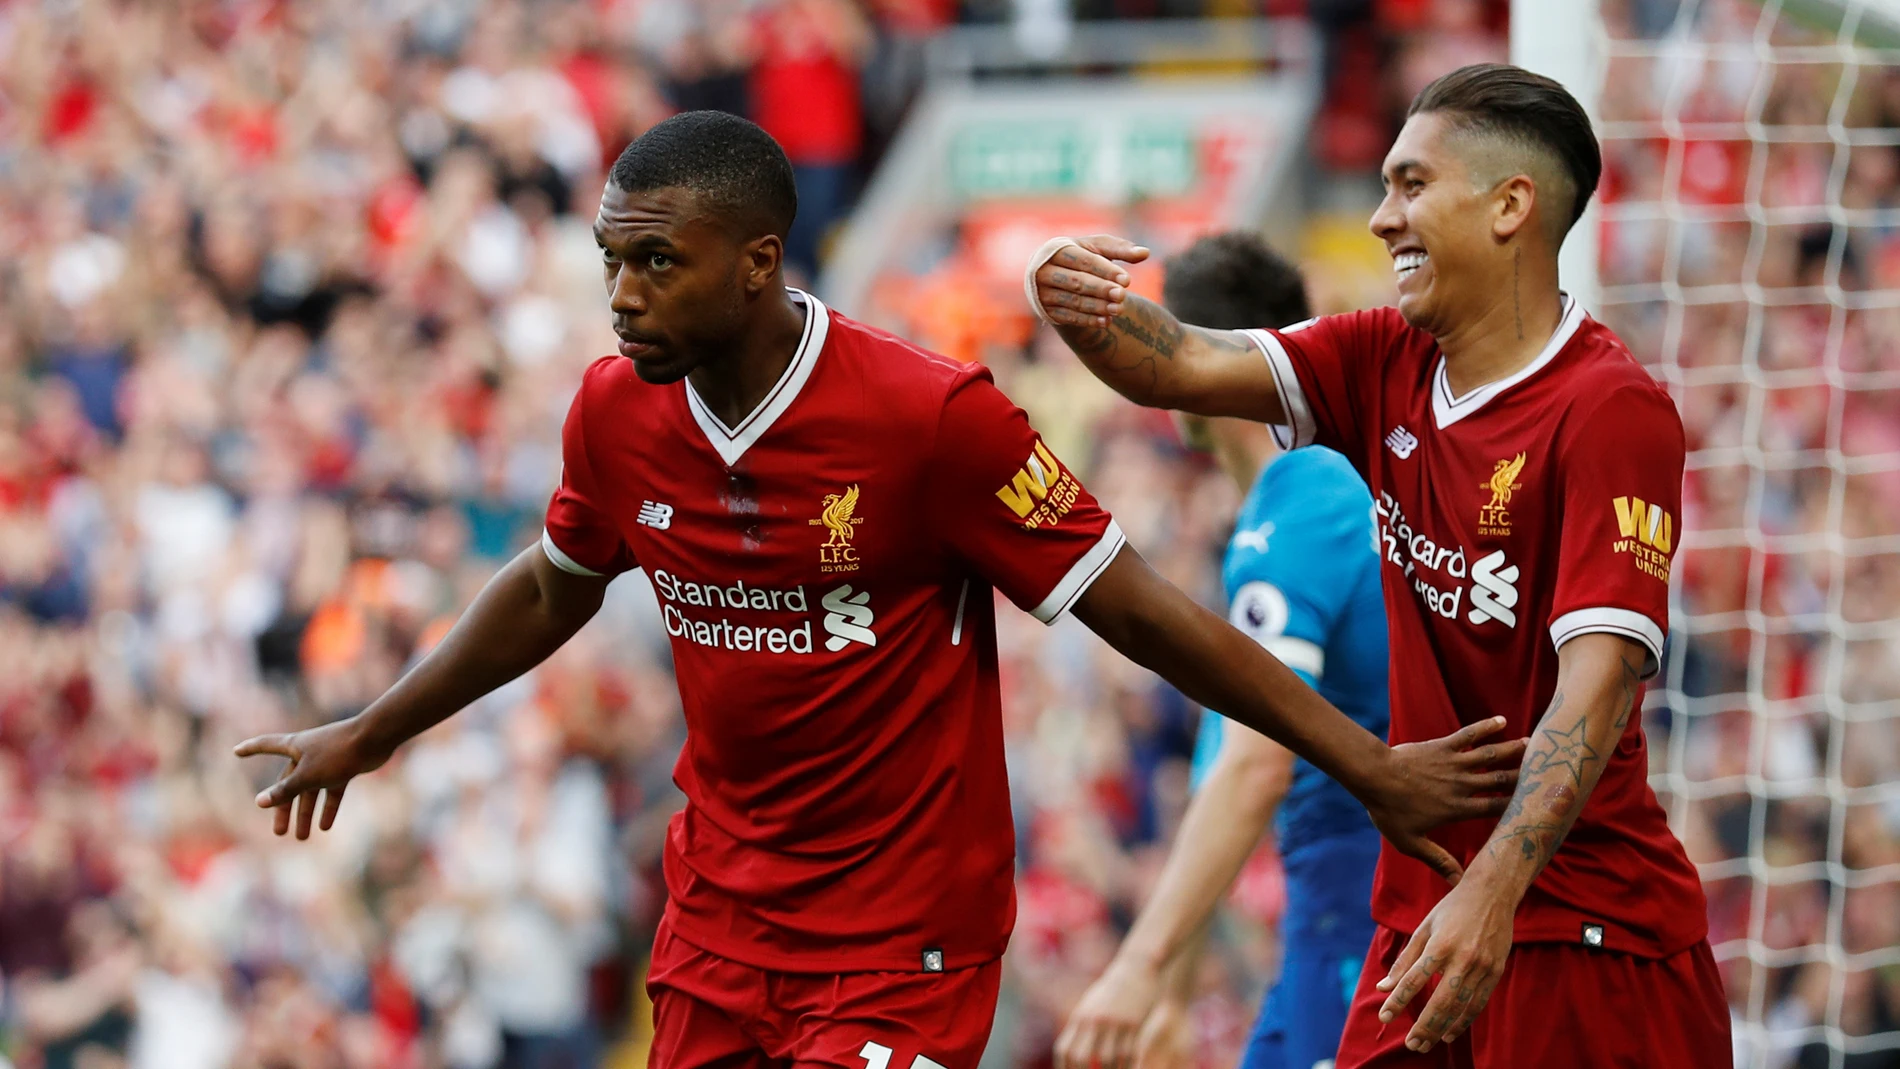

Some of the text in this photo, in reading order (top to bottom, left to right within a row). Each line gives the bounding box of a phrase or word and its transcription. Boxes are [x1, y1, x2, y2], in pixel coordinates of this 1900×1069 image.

[995, 439, 1060, 519] WU
[1021, 471, 1071, 531] WESTERN
[850, 517, 864, 525] 2017
[1046, 481, 1081, 526] UNION
[1612, 495, 1672, 554] WU
[820, 547, 861, 563] L.F.C.
[821, 563, 860, 573] 125 YEARS
[654, 569, 808, 612] Standard
[664, 603, 813, 654] Chartered
